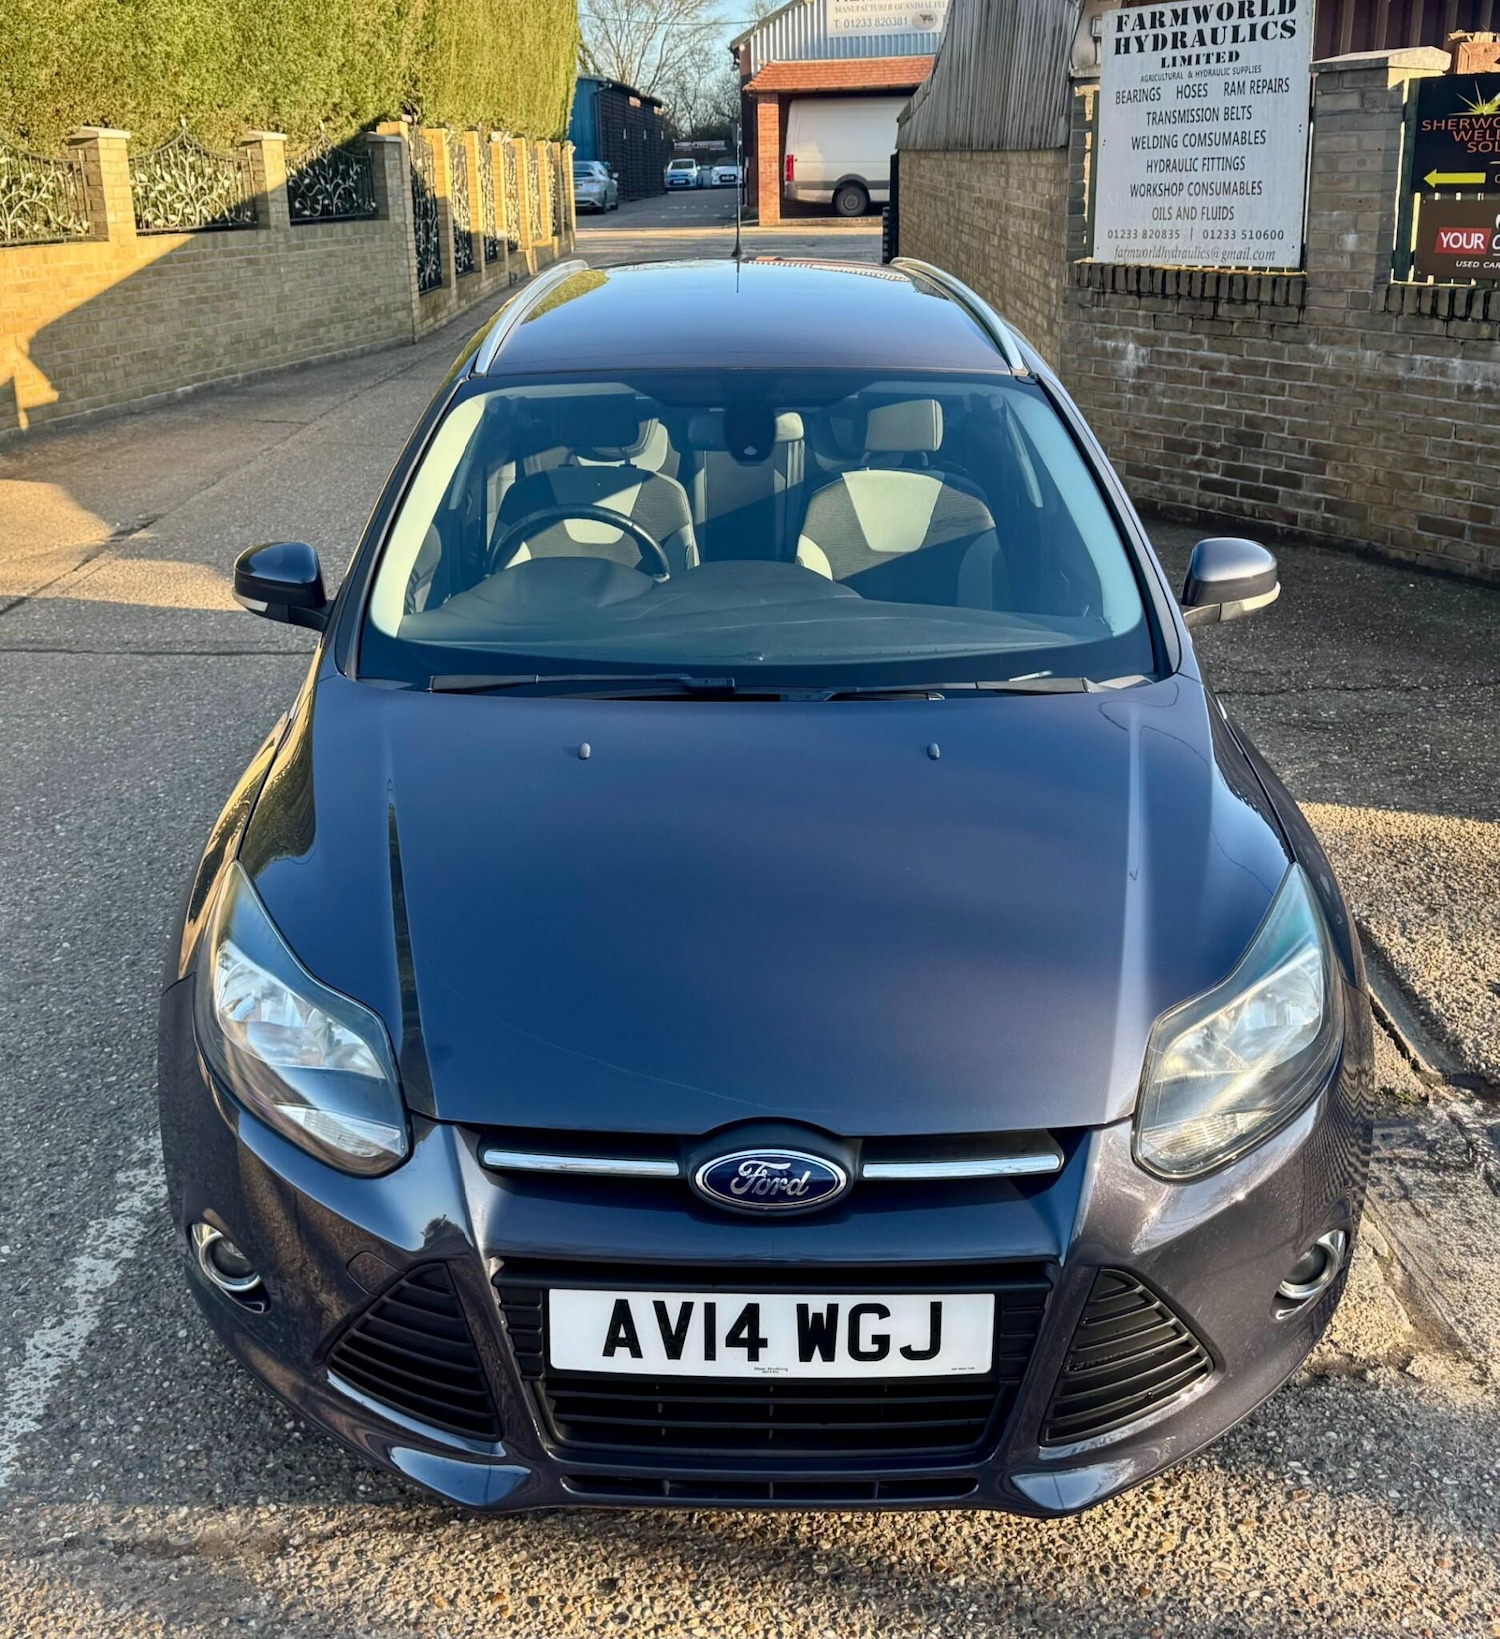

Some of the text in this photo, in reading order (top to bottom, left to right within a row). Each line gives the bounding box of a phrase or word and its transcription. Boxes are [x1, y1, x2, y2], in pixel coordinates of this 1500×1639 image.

[843, 18, 872, 28] 01233
[874, 16, 908, 27] 820381
[1115, 0, 1297, 33] FARMWORLD
[1114, 19, 1297, 56] HYDRAULICS
[1160, 50, 1240, 69] LIMITED
[1140, 65, 1262, 83] AGRICULTURAL & HYDRAULIC SUPPLIES
[1115, 78, 1290, 105] BEARINGS HOSES RAM REPAIRS
[1146, 105, 1252, 126] TRANSMISSION BELTS
[1131, 134, 1178, 150] WELDING
[1146, 156, 1246, 174] HYDRAULIC FITTINGS
[1130, 180, 1263, 197] WORKSHOP CONSUMABLES
[1152, 206, 1235, 221] OILS AND FLUIDS
[1107, 229, 1284, 240] 01233 820835 01233 510600
[1440, 232, 1485, 250] YOUR
[1114, 245, 1276, 262] farmworldhydraulics@gmail.com
[730, 1160, 812, 1196] Ford
[602, 1298, 943, 1362] AV14 WGJ
